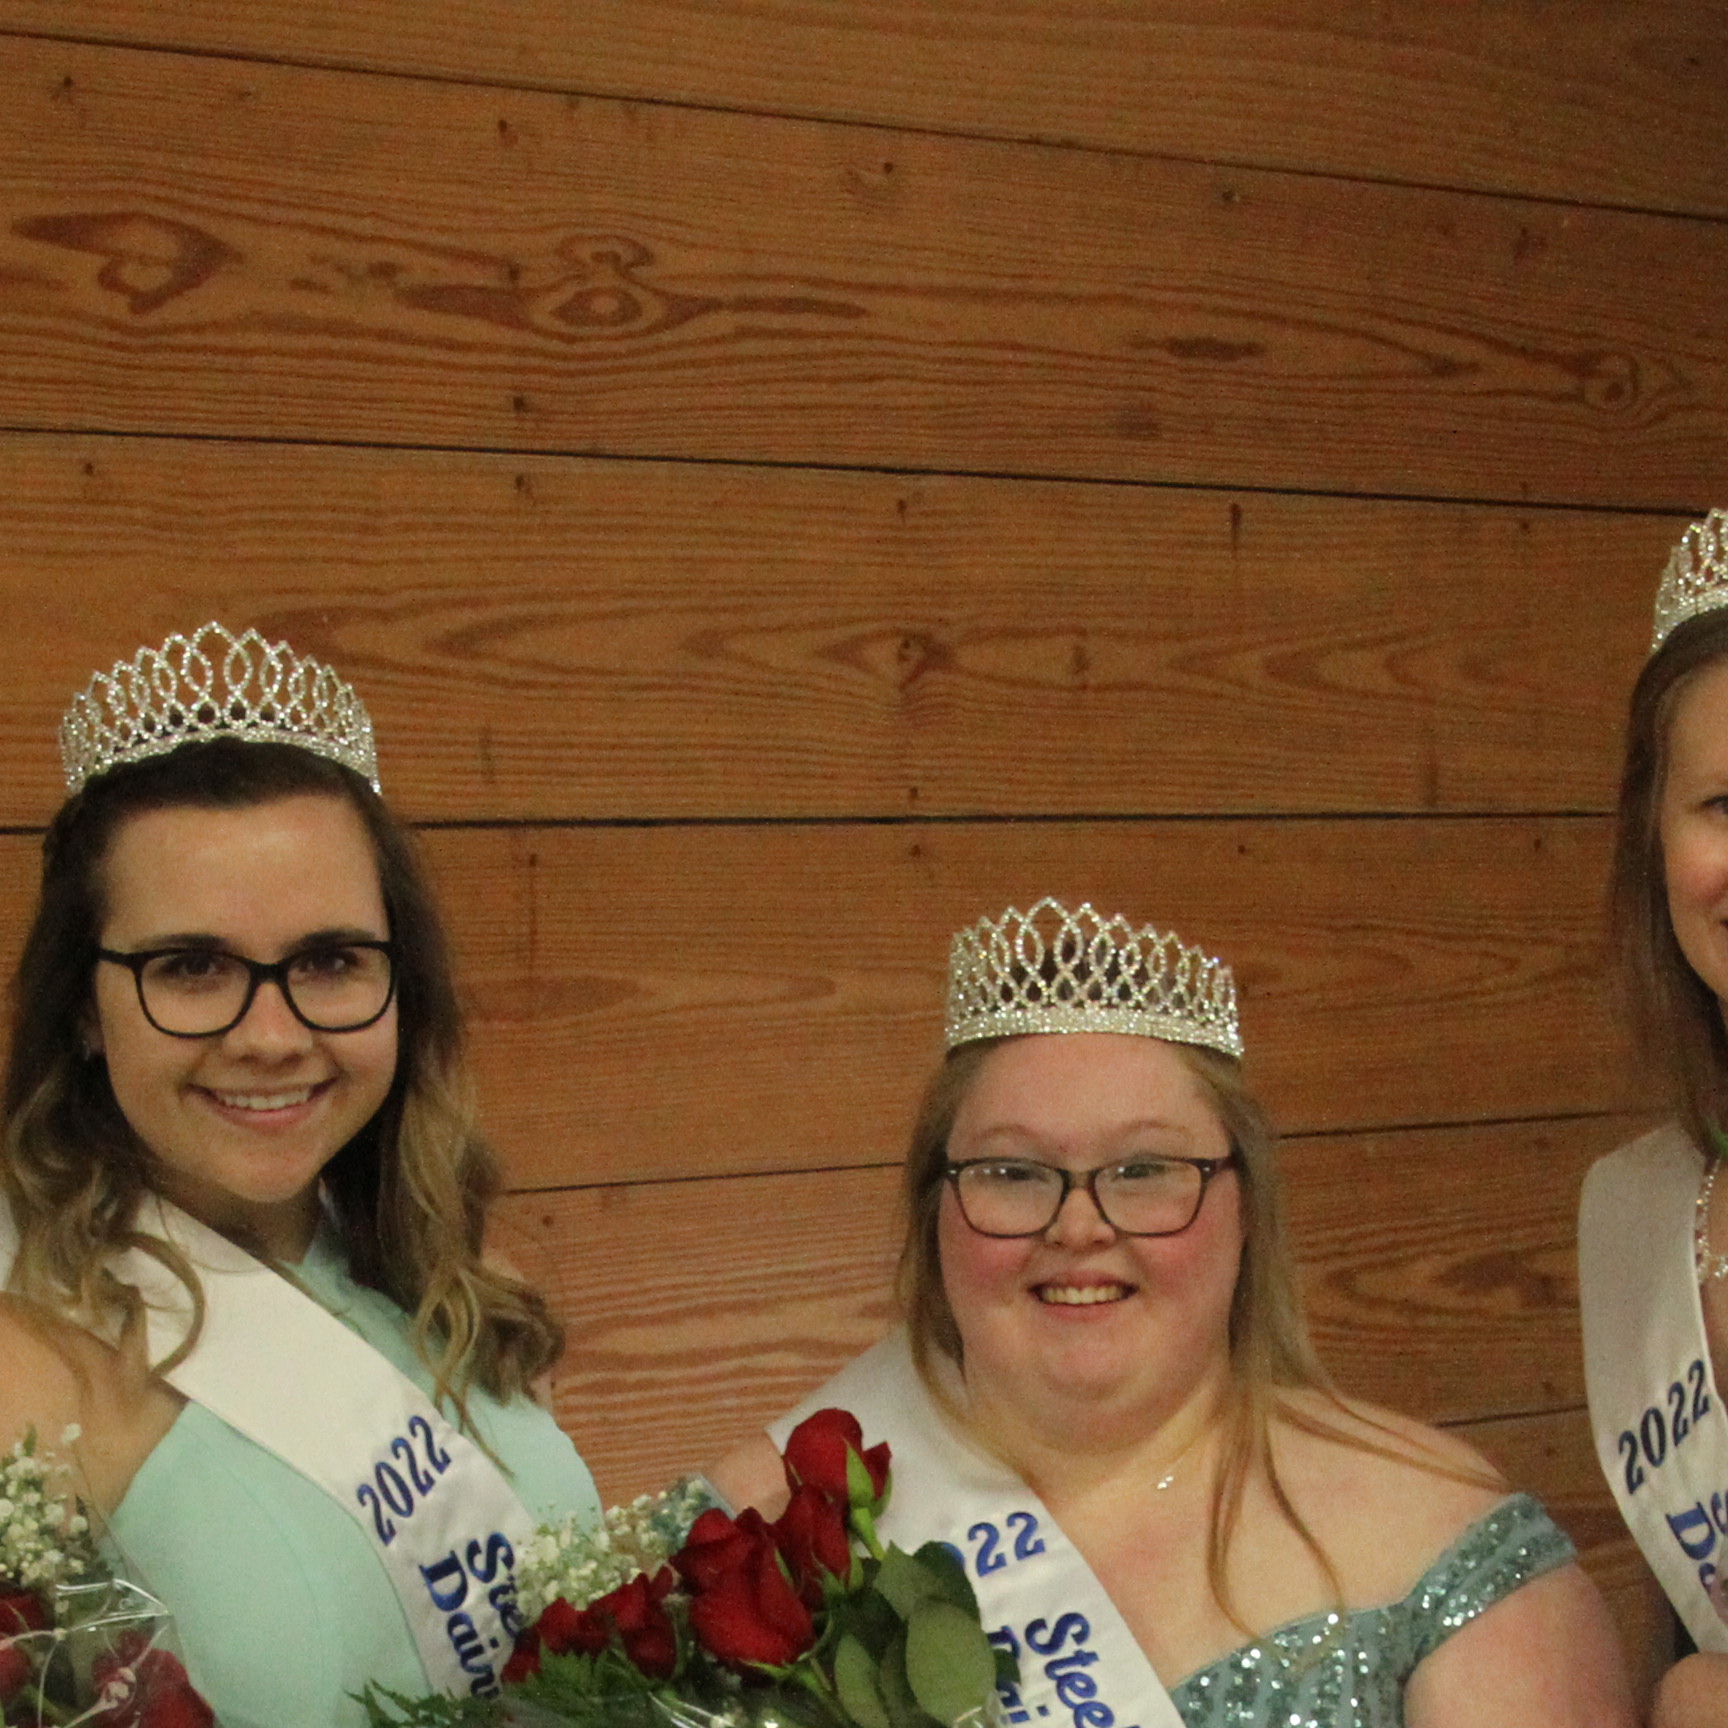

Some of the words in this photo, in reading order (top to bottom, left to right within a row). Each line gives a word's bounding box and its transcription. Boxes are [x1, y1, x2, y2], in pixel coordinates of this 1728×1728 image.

[356, 1414, 451, 1547] 2022
[1618, 1359, 1710, 1496] 2022
[466, 1532, 526, 1642] Ste
[940, 1511, 1046, 1578] 22
[418, 1549, 501, 1699] Dair
